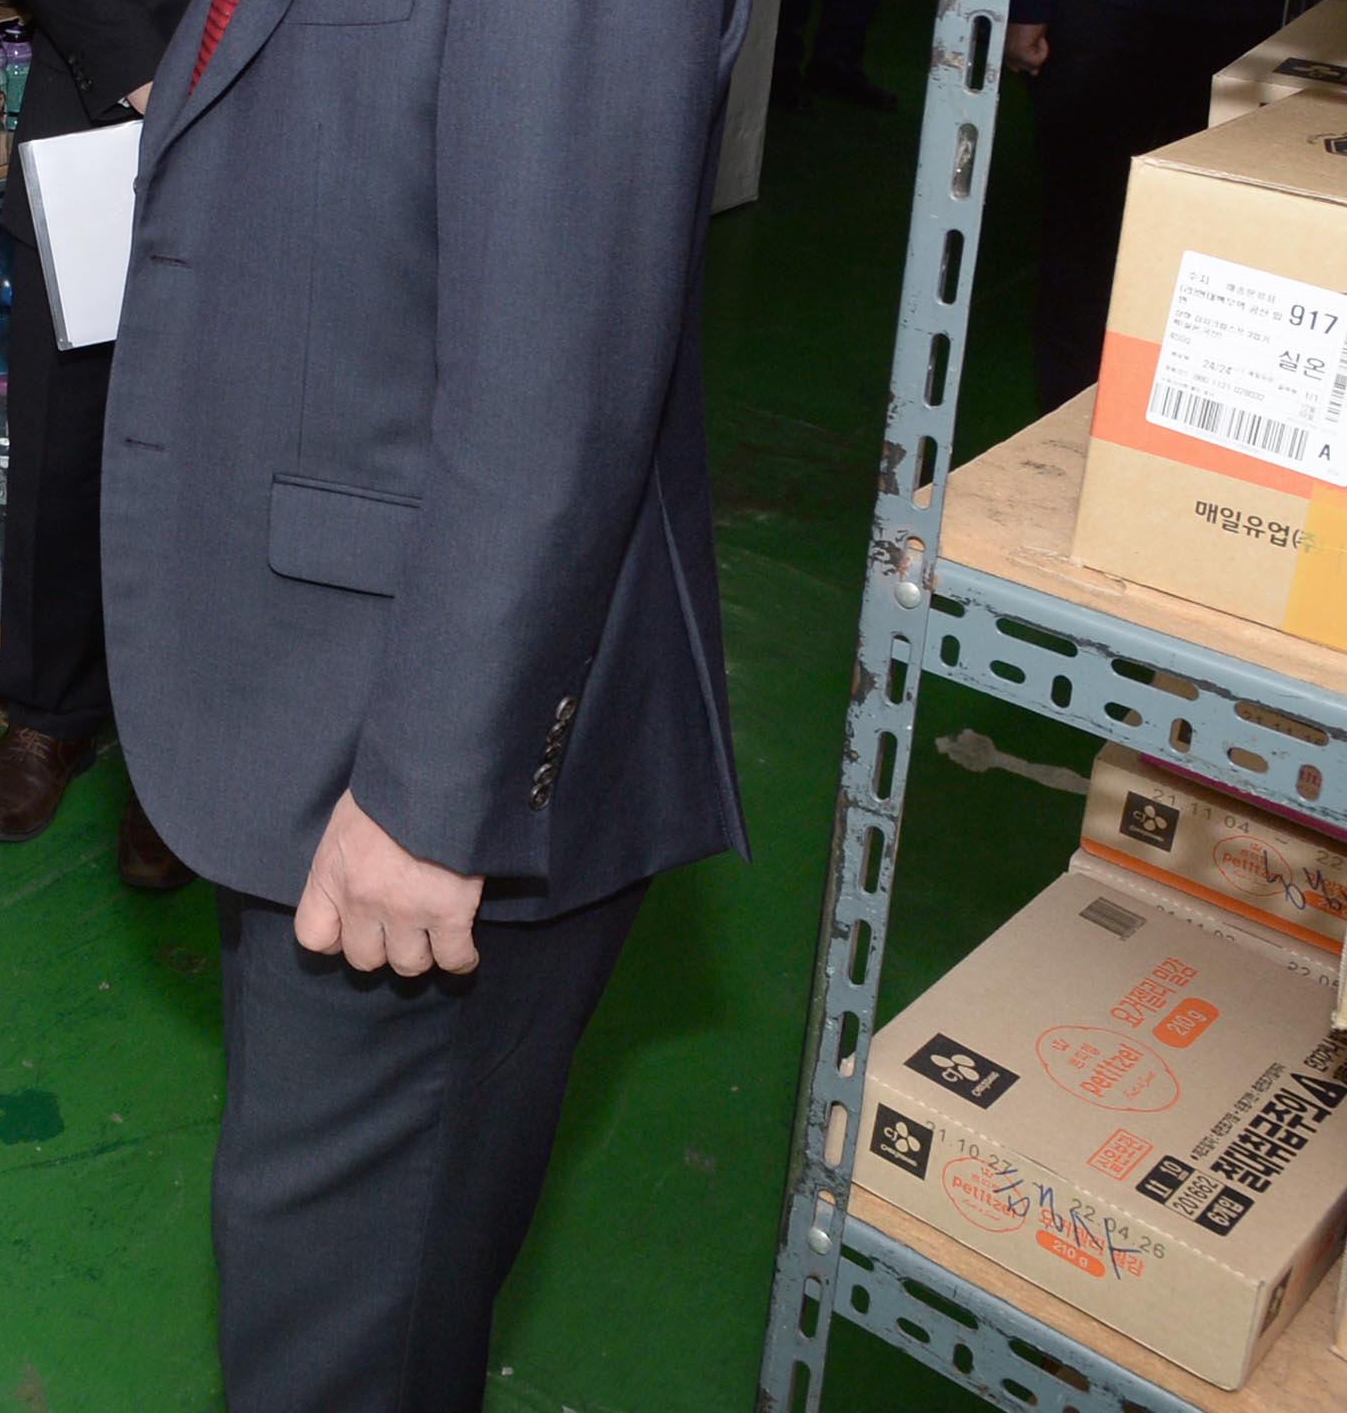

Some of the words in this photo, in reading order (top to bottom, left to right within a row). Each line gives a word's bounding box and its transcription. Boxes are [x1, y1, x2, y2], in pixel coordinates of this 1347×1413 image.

[1288, 303, 1339, 335] 917
[1278, 349, 1327, 382] 실온
[1318, 443, 1332, 462] A
[1167, 1014, 1197, 1037] 210
[940, 1067, 963, 1084] CJ
[1080, 1043, 1144, 1099] petitzel
[883, 1126, 899, 1139] CJ
[1210, 1087, 1333, 1194] 절대취급주의
[1096, 1133, 1144, 1174] 실온보관
[1144, 1179, 1170, 1199] 11
[1164, 1161, 1187, 1181] 10
[1173, 1175, 1219, 1217] 201662
[1207, 1195, 1245, 1227] 6개입
[1072, 1197, 1166, 1260] 22.04.26
[1053, 1239, 1078, 1259] 210
